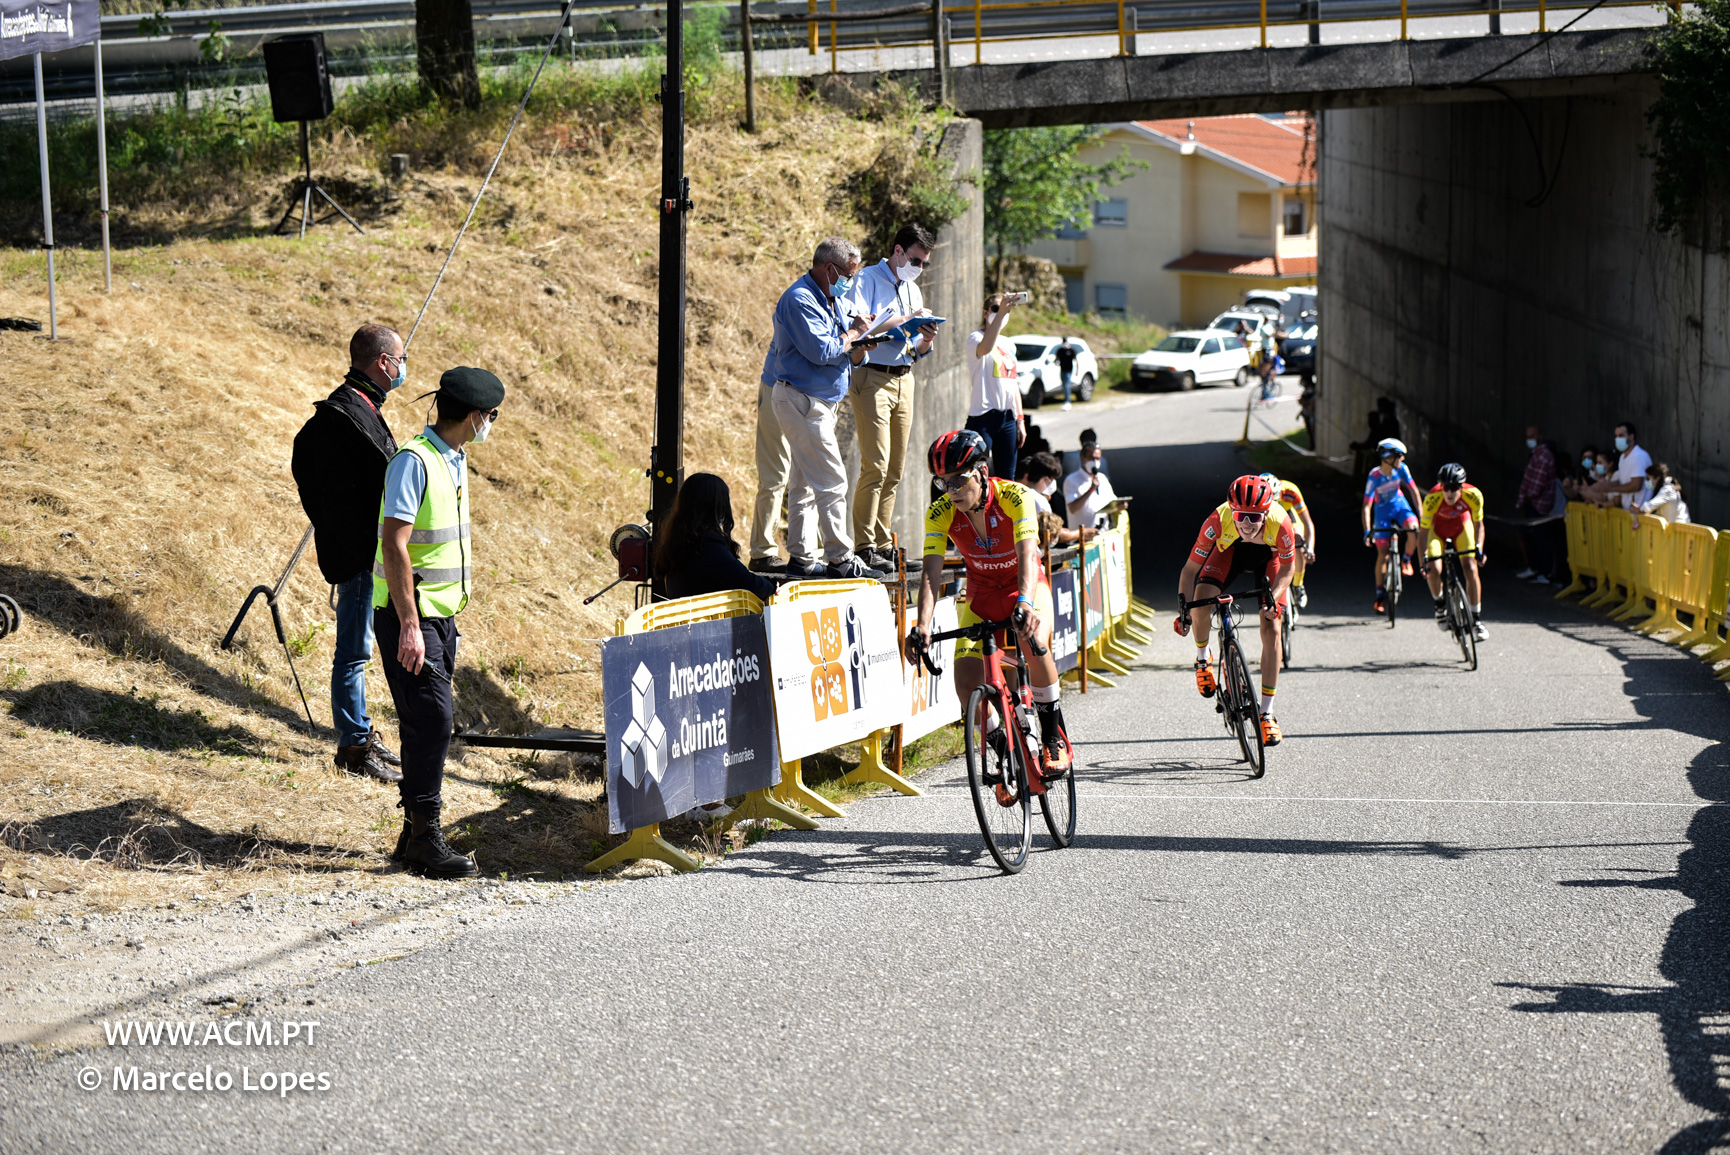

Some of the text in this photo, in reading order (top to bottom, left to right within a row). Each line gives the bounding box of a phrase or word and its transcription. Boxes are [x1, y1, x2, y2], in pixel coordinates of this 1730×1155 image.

[669, 648, 760, 700] Arrecadações
[672, 708, 727, 759] da Quintã
[723, 747, 755, 767] Guimarães
